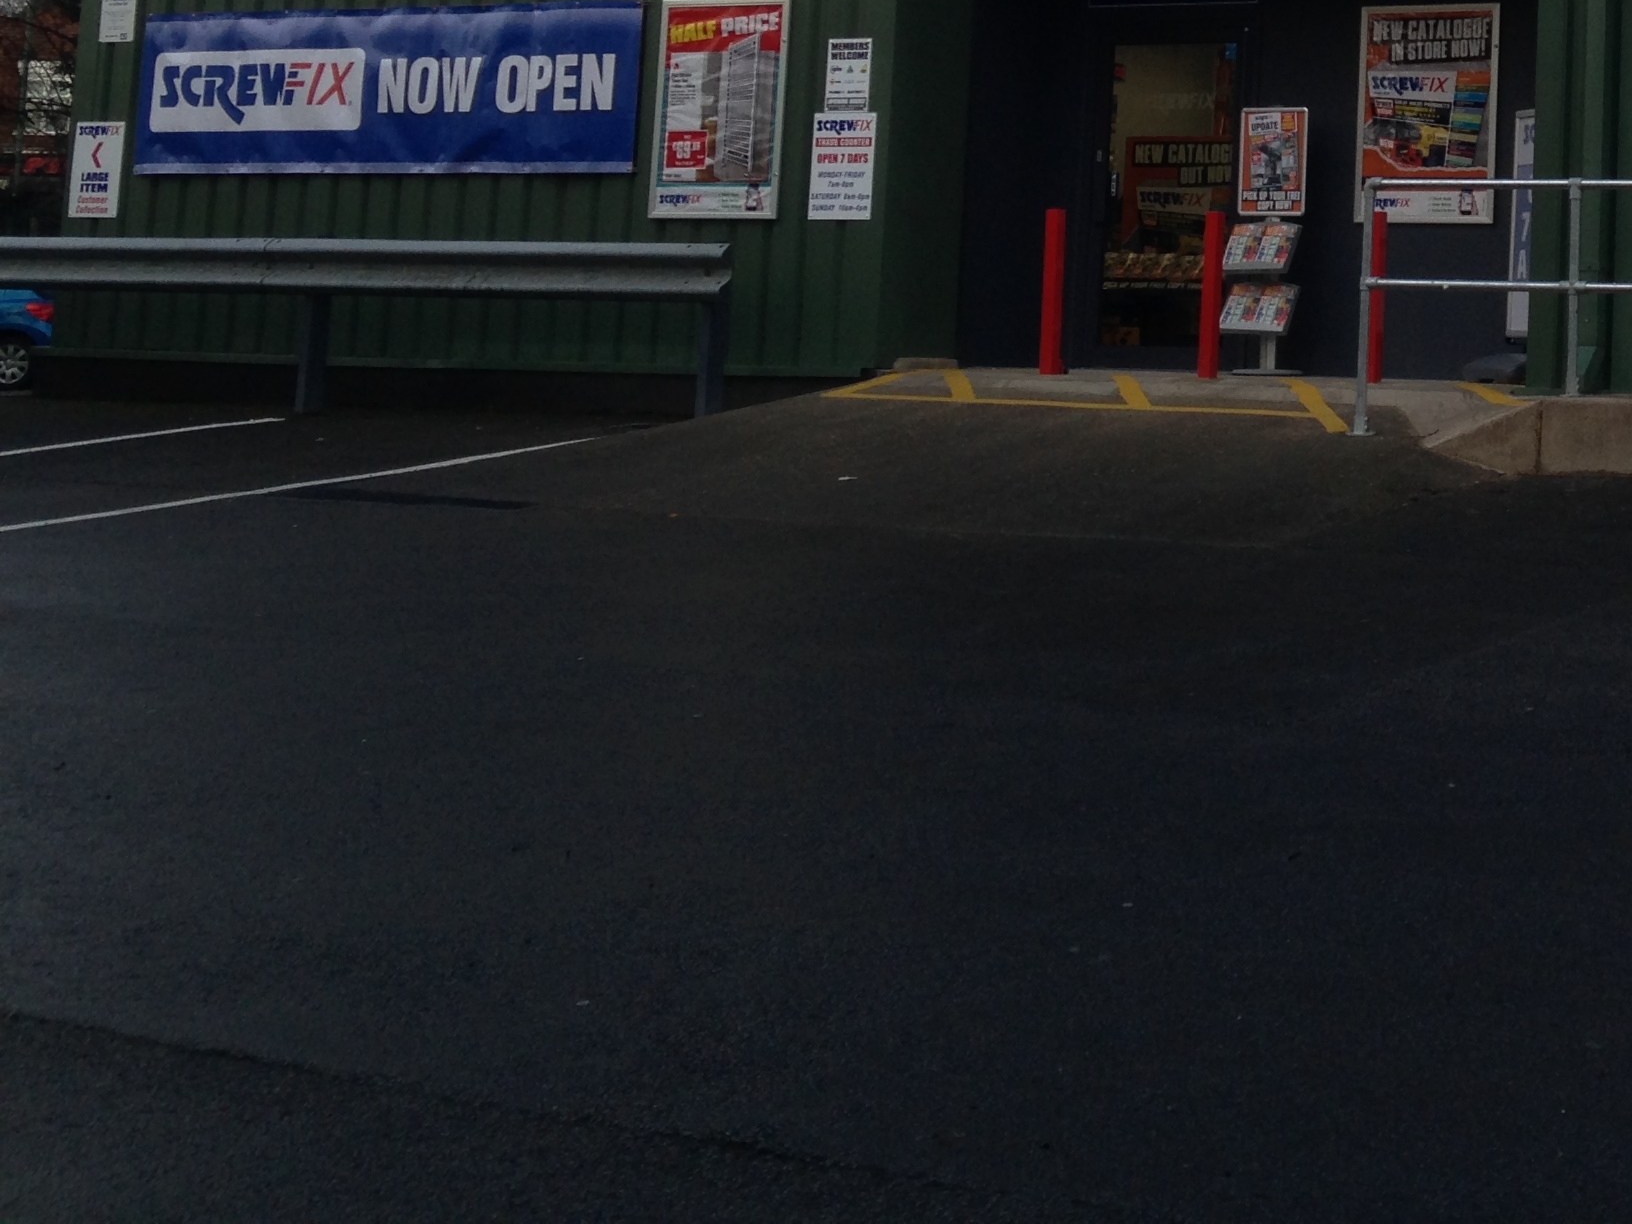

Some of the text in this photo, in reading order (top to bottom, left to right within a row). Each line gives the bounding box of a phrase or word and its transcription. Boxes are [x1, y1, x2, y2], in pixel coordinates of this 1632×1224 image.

[670, 11, 780, 44] HALF PRICE
[1373, 17, 1492, 43] NEW CATALOGUE
[831, 42, 870, 51] MEMBERS
[1391, 38, 1486, 62] IN STORE NOW!
[831, 52, 868, 60] WELCOME
[160, 62, 354, 125] SCREWFIX
[377, 55, 482, 114] NOW
[495, 52, 616, 114] OPEN
[1372, 76, 1448, 95] SCREWFIX
[79, 126, 120, 139] SCREWFIX
[817, 120, 872, 135] SCREWFIX
[1251, 122, 1279, 132] UPDATE
[817, 154, 838, 163] OPEN
[847, 153, 868, 163] DAYS
[1135, 143, 1232, 164] NEW CATALOG
[81, 172, 109, 182] LARGE
[1180, 167, 1204, 184] OUT
[80, 183, 108, 192] ITEM
[659, 194, 702, 207] SCREWFIX
[1139, 190, 1205, 208] SCREWFIX
[1374, 197, 1410, 210] REWFIX
